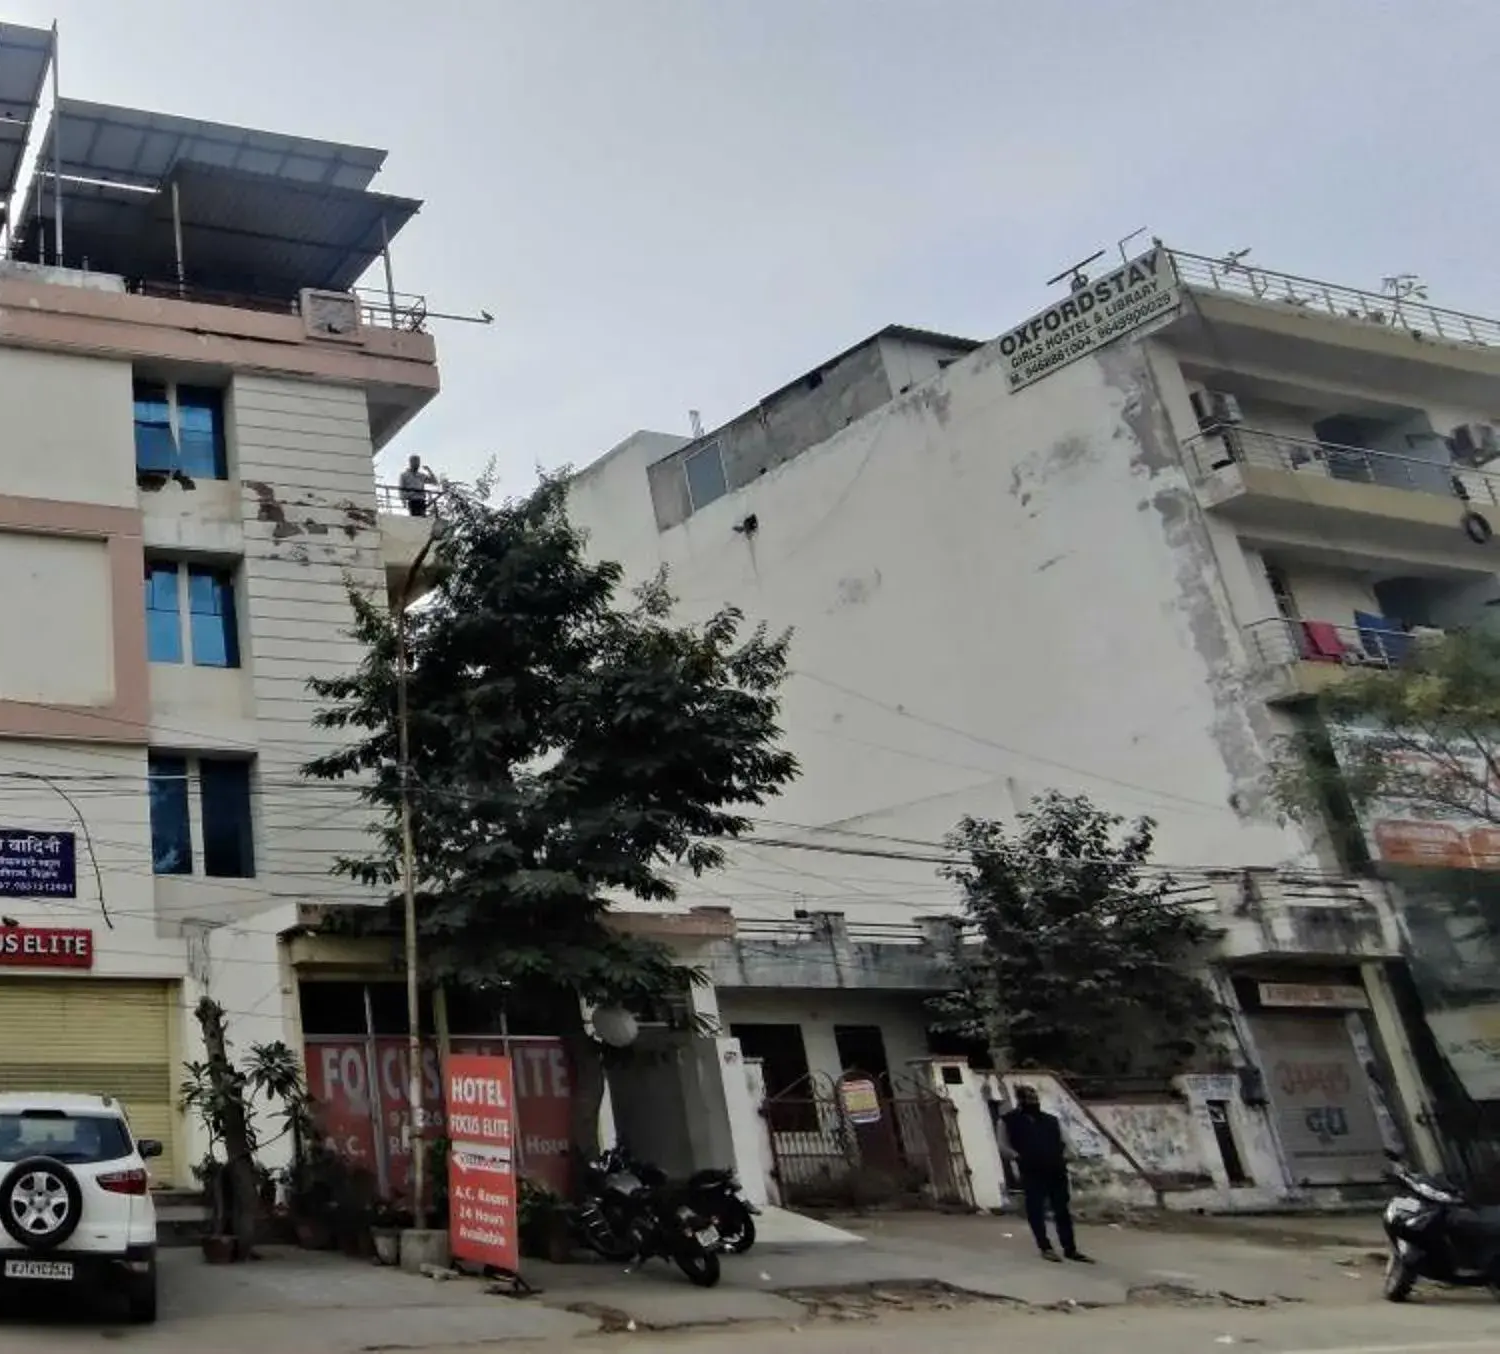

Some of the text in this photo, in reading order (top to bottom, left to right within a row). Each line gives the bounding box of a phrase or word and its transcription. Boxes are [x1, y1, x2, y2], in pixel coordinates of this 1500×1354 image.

[1000, 251, 1159, 356] OXFORDSTAY
[1011, 342, 1043, 368] GIRLS
[1047, 318, 1090, 350] HOSTEL
[1105, 281, 1158, 317] LIBRARY
[8, 835, 61, 853] वादिनी
[23, 934, 88, 955] ELITE
[451, 1076, 506, 1107] HOTEL
[450, 1114, 480, 1135] FOCUS
[483, 1117, 510, 1138] ELITE
[478, 1187, 508, 1206] Room
